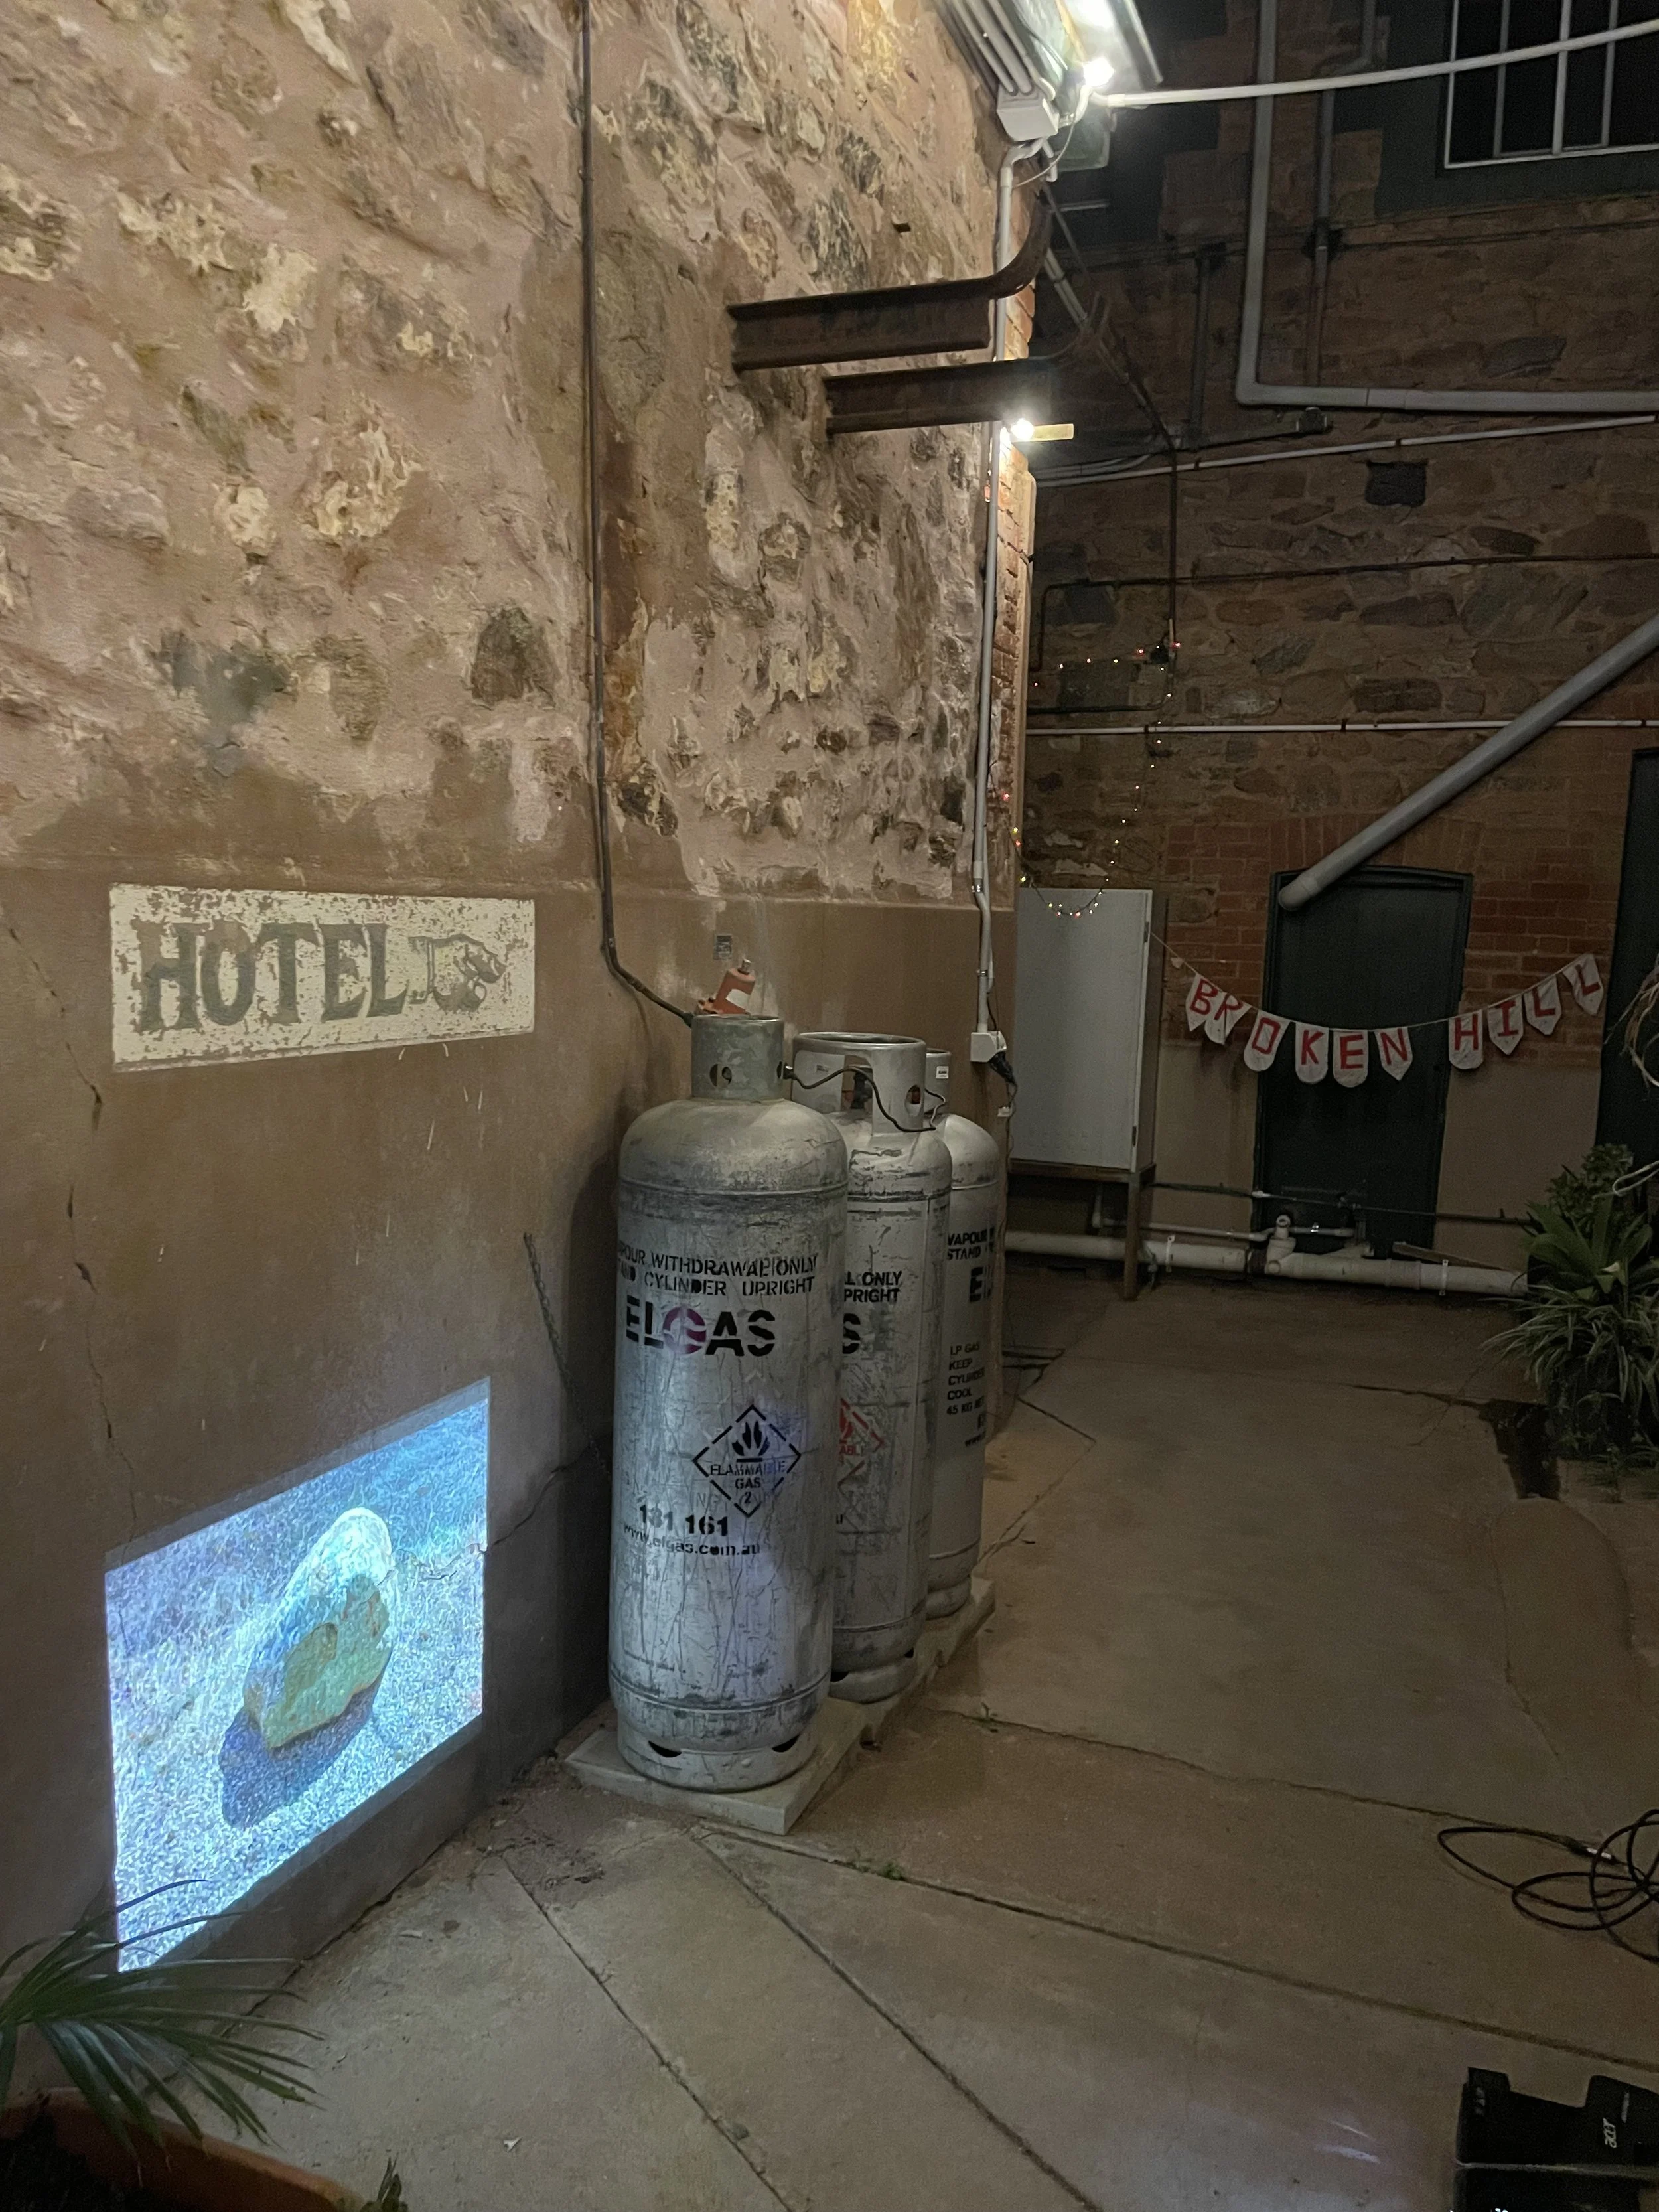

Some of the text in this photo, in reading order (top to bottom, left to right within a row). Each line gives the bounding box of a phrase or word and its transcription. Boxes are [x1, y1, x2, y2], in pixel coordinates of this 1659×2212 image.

[131, 918, 410, 1033] HOTEL
[1189, 964, 1602, 1069] BROKEN HILL
[947, 1245, 981, 1261] STAND
[650, 1250, 768, 1278] WITHDRAWAL
[776, 1252, 819, 1276] ONLY
[644, 1271, 727, 1296] CYLINDER
[742, 1276, 816, 1296] UPRIGHT
[862, 1270, 902, 1286] ONLY
[844, 1288, 901, 1303] PRIGHT
[626, 1294, 776, 1357] ELGAS
[950, 1341, 980, 1356] LP GAS
[948, 1357, 973, 1370] KEEP
[947, 1387, 972, 1400] COOL
[735, 1477, 761, 1489] GAS
[685, 1514, 729, 1536] 161
[1603, 2117, 1617, 2148] acer
